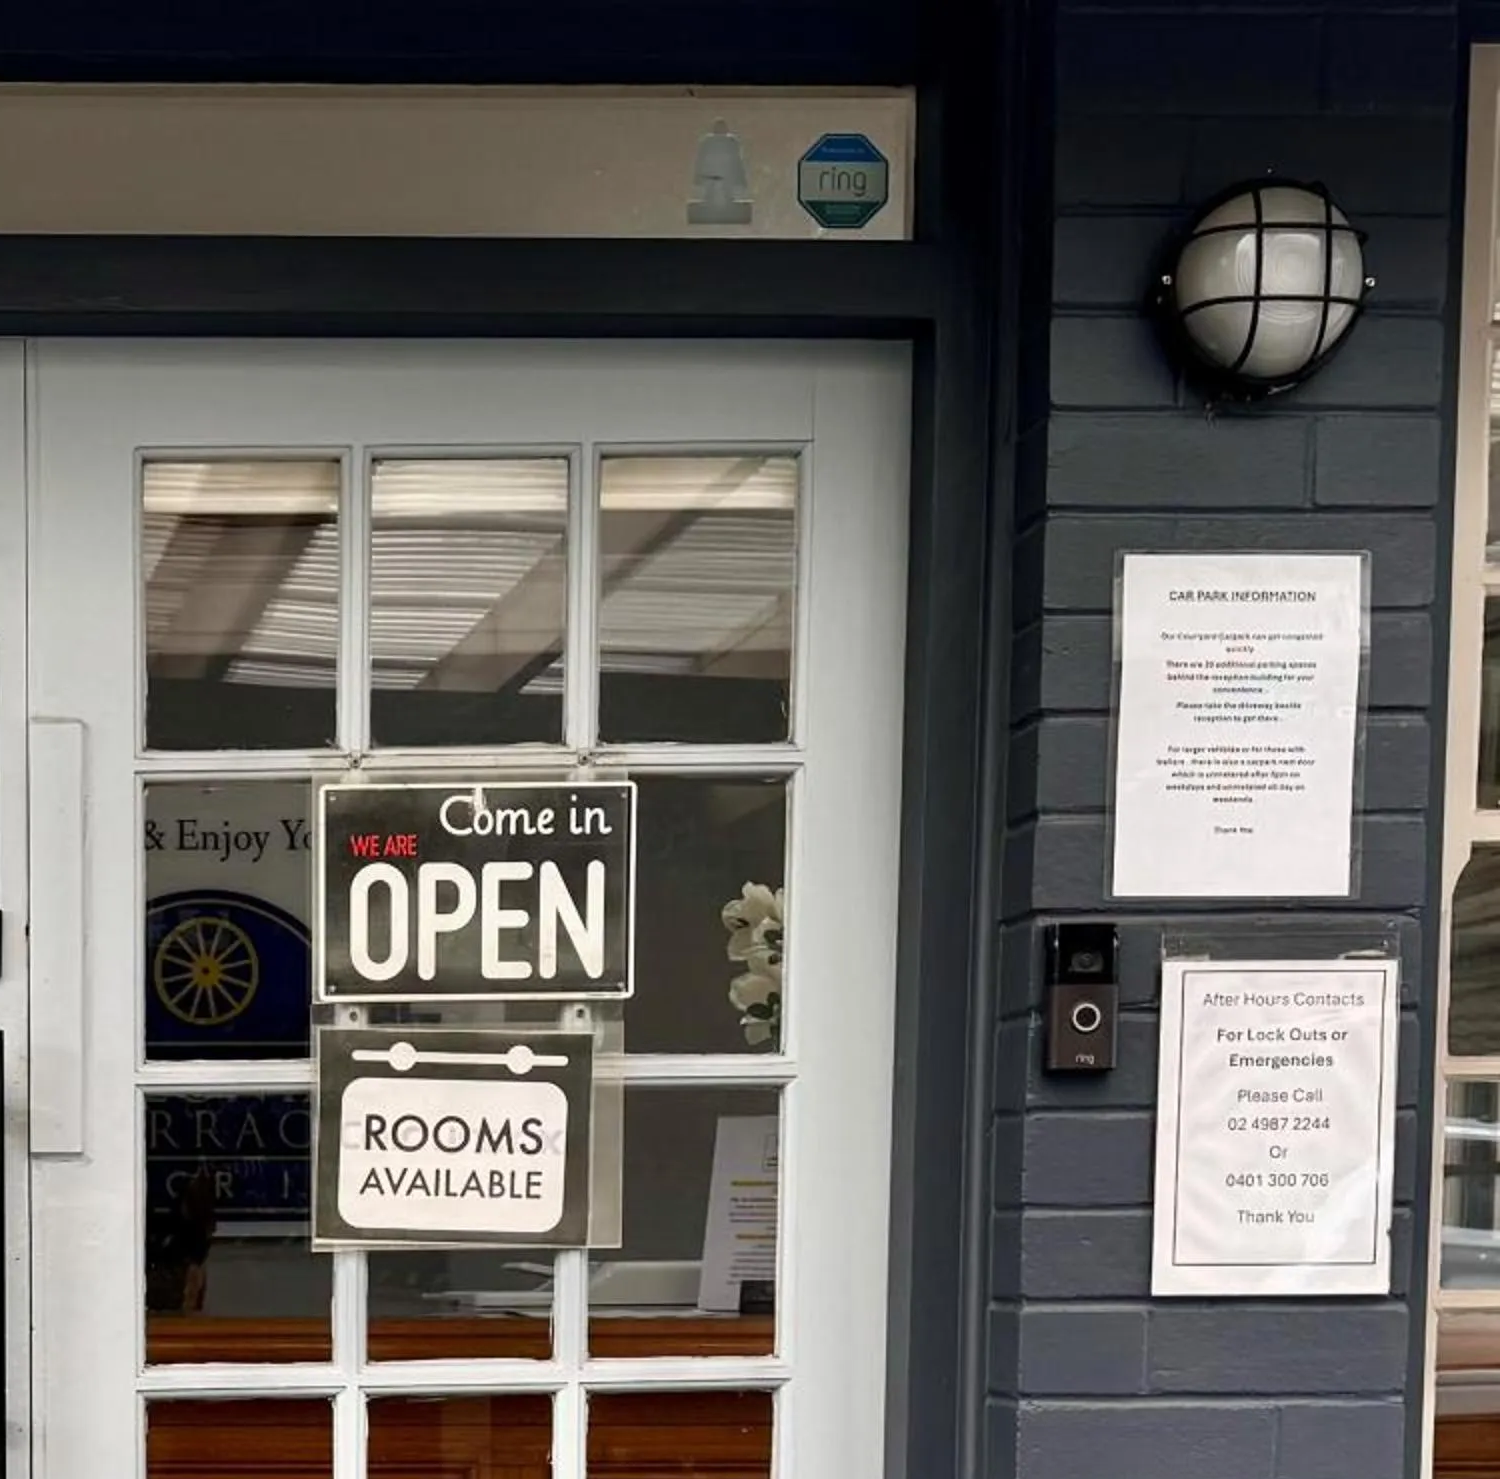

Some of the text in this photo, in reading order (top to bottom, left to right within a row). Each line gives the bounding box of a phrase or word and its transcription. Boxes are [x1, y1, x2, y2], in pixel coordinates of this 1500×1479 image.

[819, 166, 867, 197] ring
[1169, 591, 1316, 602] CAR PARK INFORMATION
[439, 794, 612, 835] Come in
[145, 819, 165, 851] &
[175, 819, 270, 863] Enjoy
[350, 834, 417, 857] WE ARE
[349, 860, 606, 981] OPEN
[1203, 992, 1365, 1006] After Hours Contacts
[1217, 1027, 1348, 1042] For Lock Outs or
[1076, 1054, 1094, 1065] ring
[1229, 1052, 1334, 1069] Emergencies
[1237, 1088, 1323, 1102] Please Call
[1227, 1116, 1331, 1131] 02 4987 2244
[365, 1114, 543, 1155] ROOMS
[1269, 1145, 1288, 1159] Or
[359, 1167, 543, 1200] AVAILABLE
[1225, 1173, 1329, 1187] 0401 300 706
[1237, 1210, 1315, 1224] Thank You
